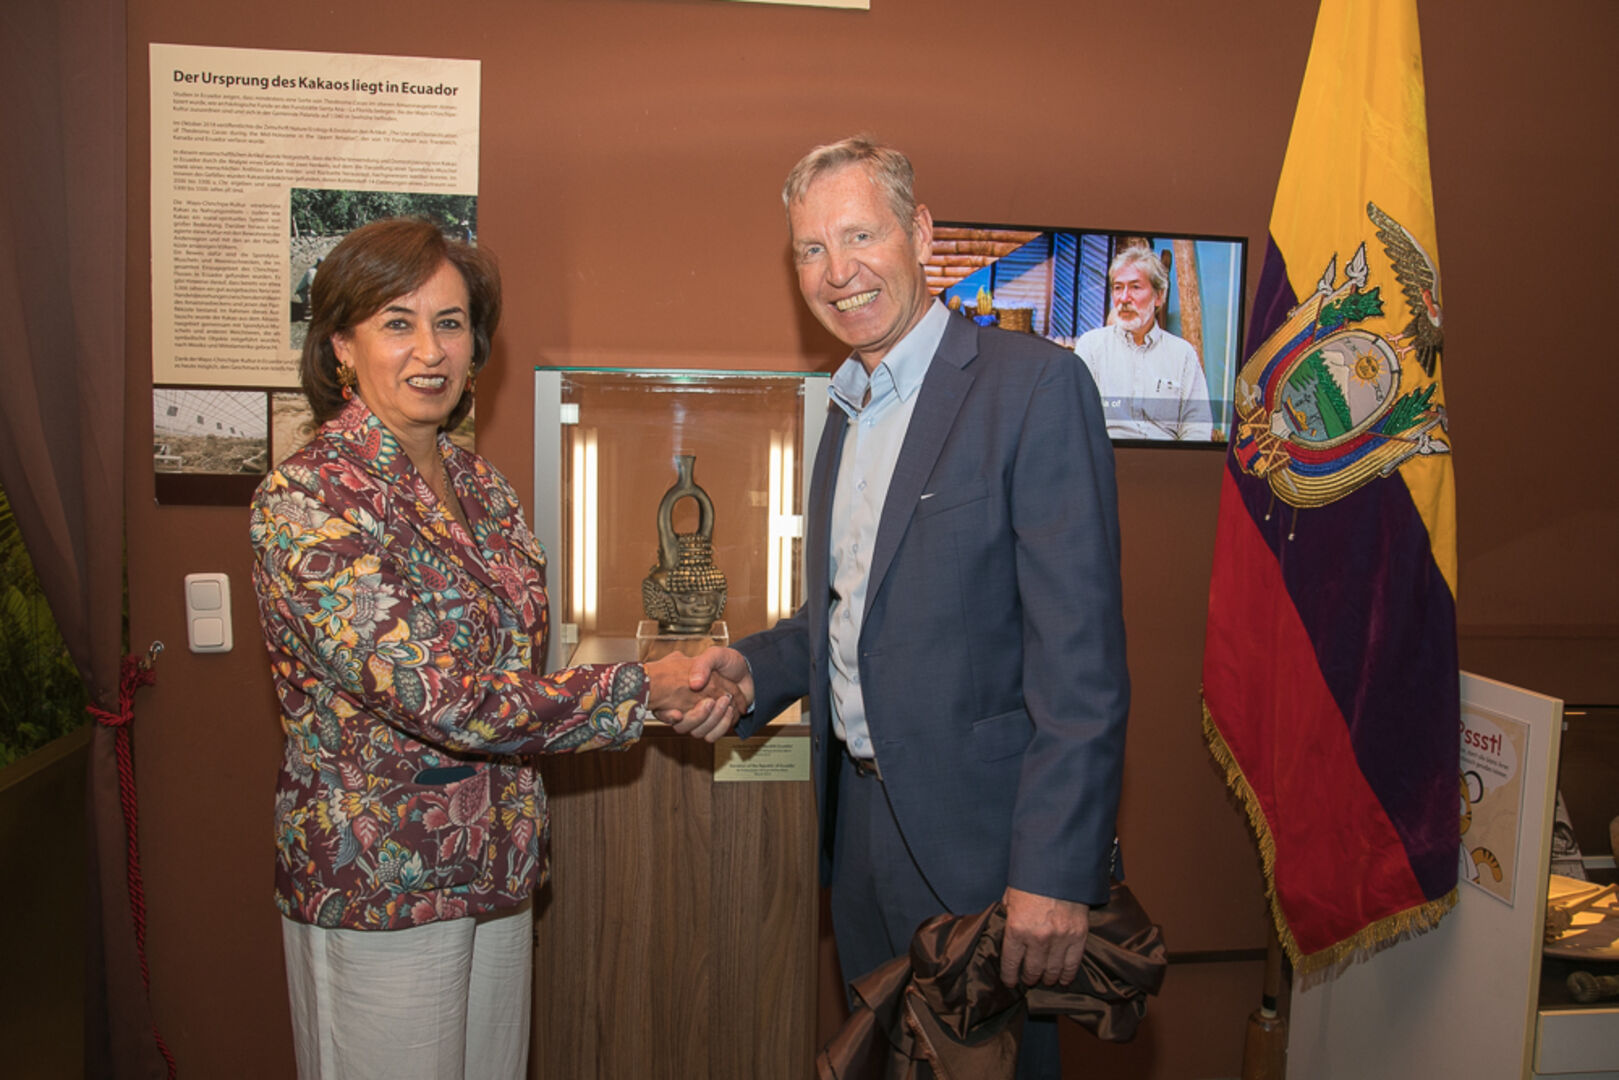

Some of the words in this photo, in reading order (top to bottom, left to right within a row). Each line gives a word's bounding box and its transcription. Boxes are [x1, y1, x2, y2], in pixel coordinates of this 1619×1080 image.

[173, 70, 199, 84] Der
[202, 72, 269, 89] Ursprung
[271, 75, 296, 88] des
[299, 77, 350, 91] Kakaos
[352, 79, 384, 94] liegt
[386, 81, 399, 93] in
[402, 82, 459, 96] Ecuador
